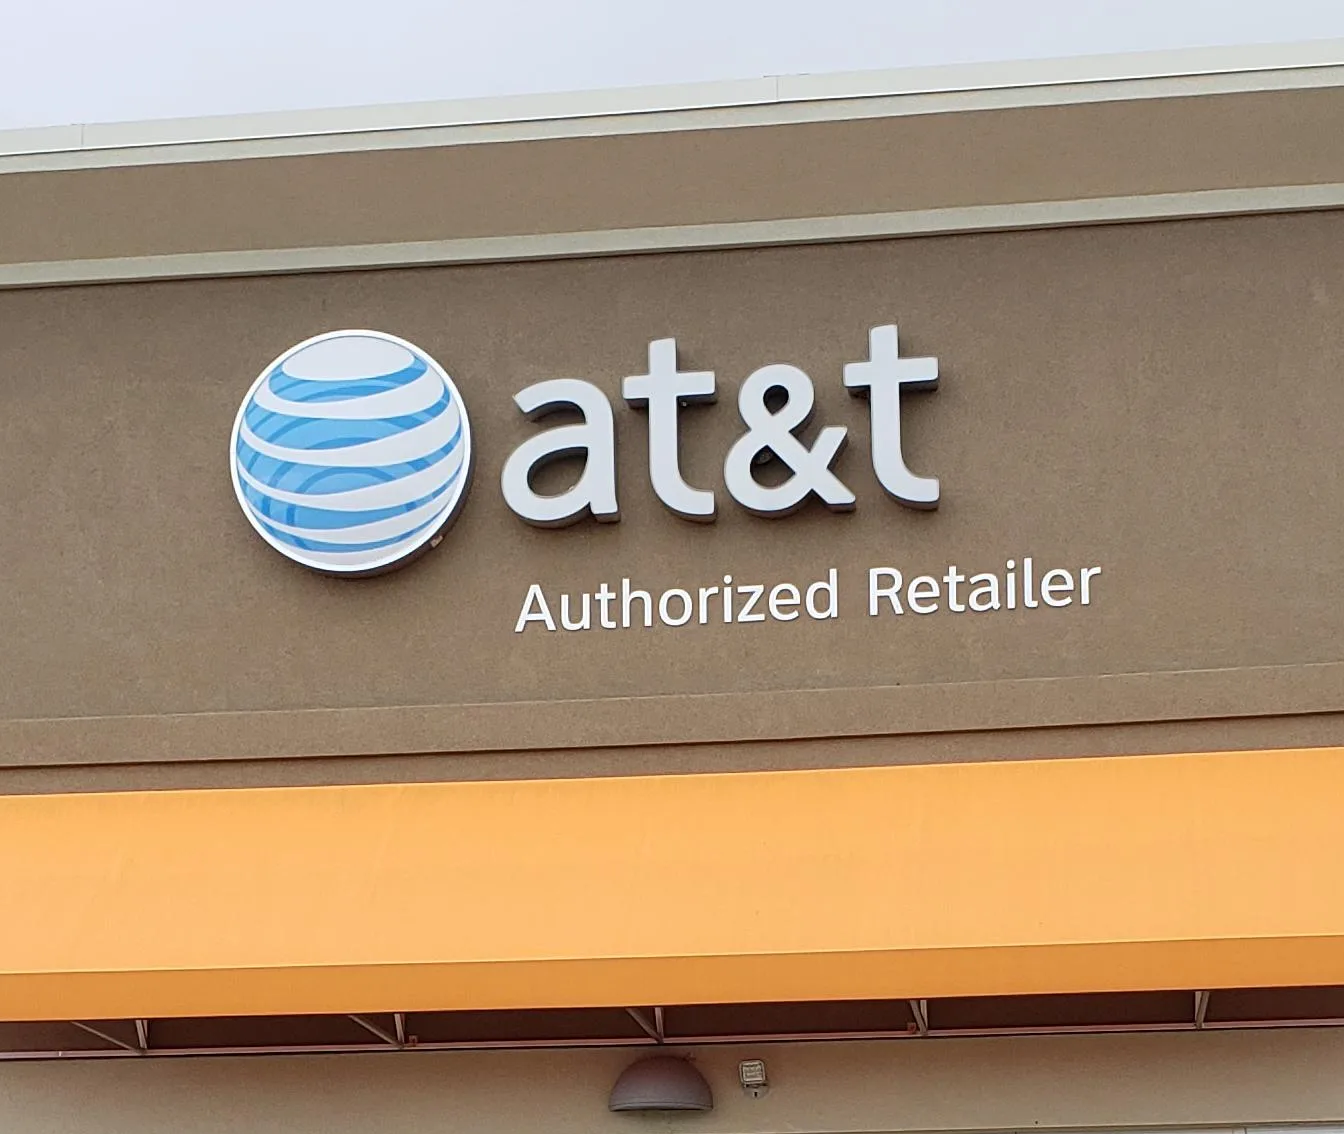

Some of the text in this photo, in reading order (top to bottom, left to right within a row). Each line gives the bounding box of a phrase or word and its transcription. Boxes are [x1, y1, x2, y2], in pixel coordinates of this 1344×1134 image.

[501, 324, 940, 522] at&t
[514, 556, 1103, 633] Authorized Retailer
